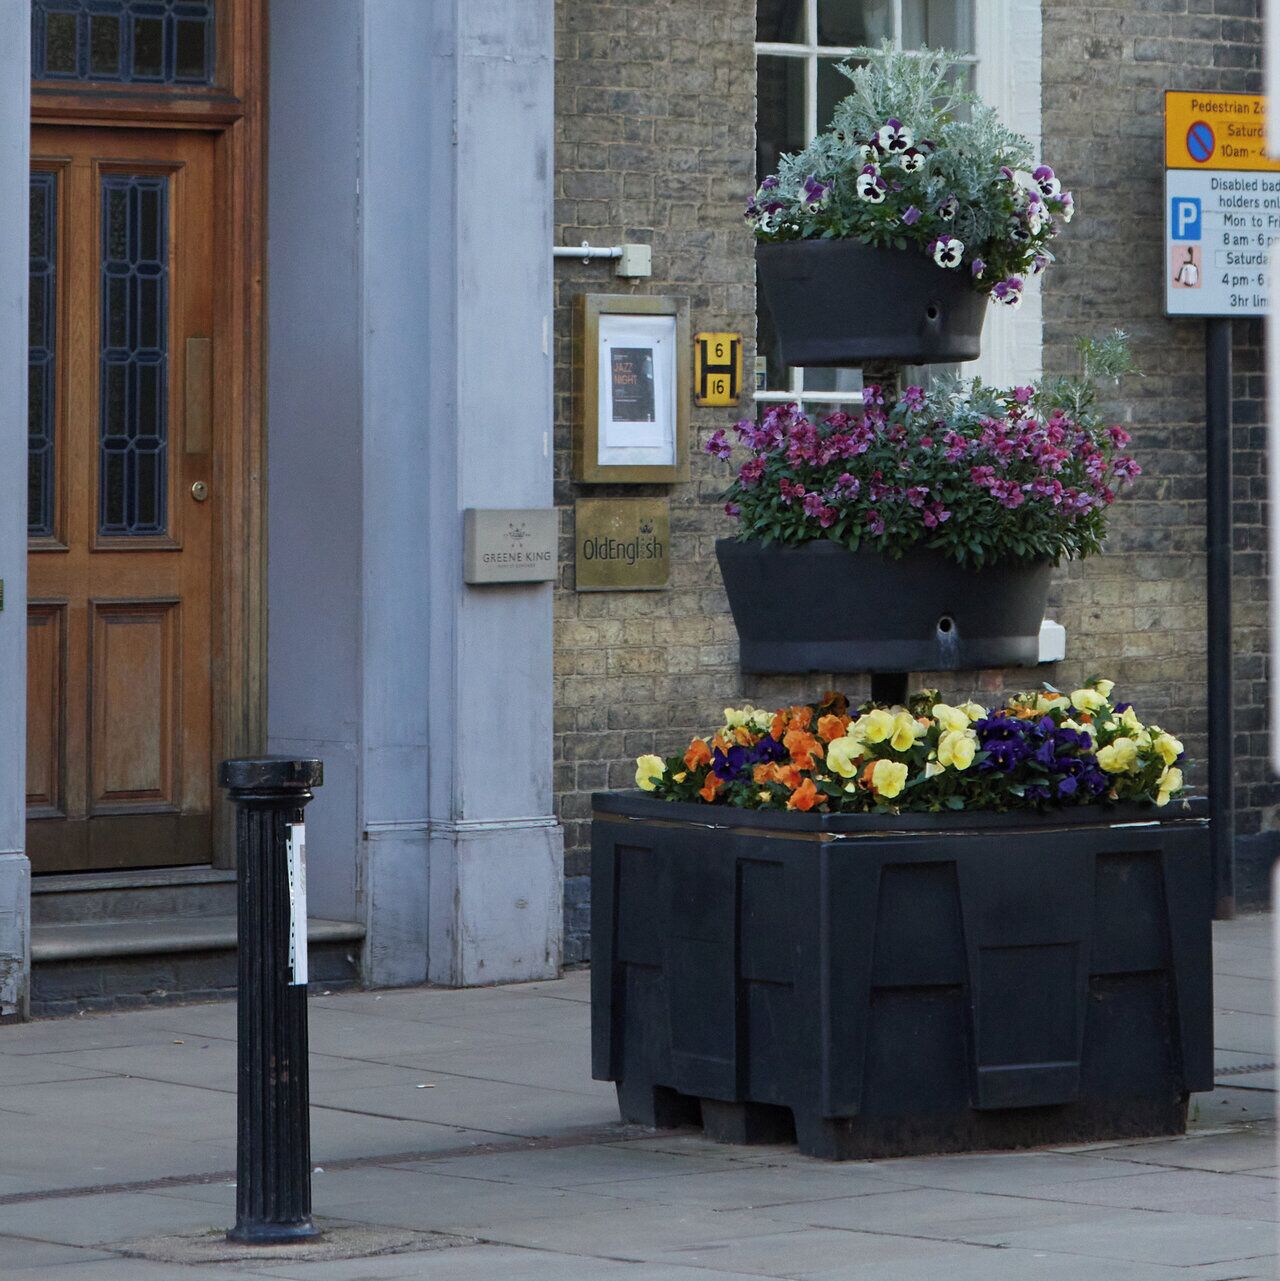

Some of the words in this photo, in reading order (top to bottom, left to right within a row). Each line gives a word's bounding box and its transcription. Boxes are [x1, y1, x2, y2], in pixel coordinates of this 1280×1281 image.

[1191, 99, 1250, 114] Pedestrian
[1221, 144, 1248, 158] 10am
[1211, 177, 1258, 192] Disabled
[1219, 194, 1260, 208] holders
[1179, 202, 1197, 236] P
[1223, 213, 1246, 226] Mon
[1252, 215, 1263, 227] to
[1268, 215, 1280, 228] Fri
[1223, 232, 1230, 245] 8
[1233, 235, 1249, 246] am
[1257, 233, 1265, 246] 6
[1226, 251, 1270, 265] Saturda
[1222, 272, 1229, 286] 4
[1232, 275, 1249, 288] pm
[1257, 273, 1265, 286] 6
[1230, 293, 1249, 308] 3hr
[715, 343, 724, 358] 6
[713, 379, 724, 394] 16
[483, 552, 522, 563] GREENE
[525, 551, 551, 562] KING
